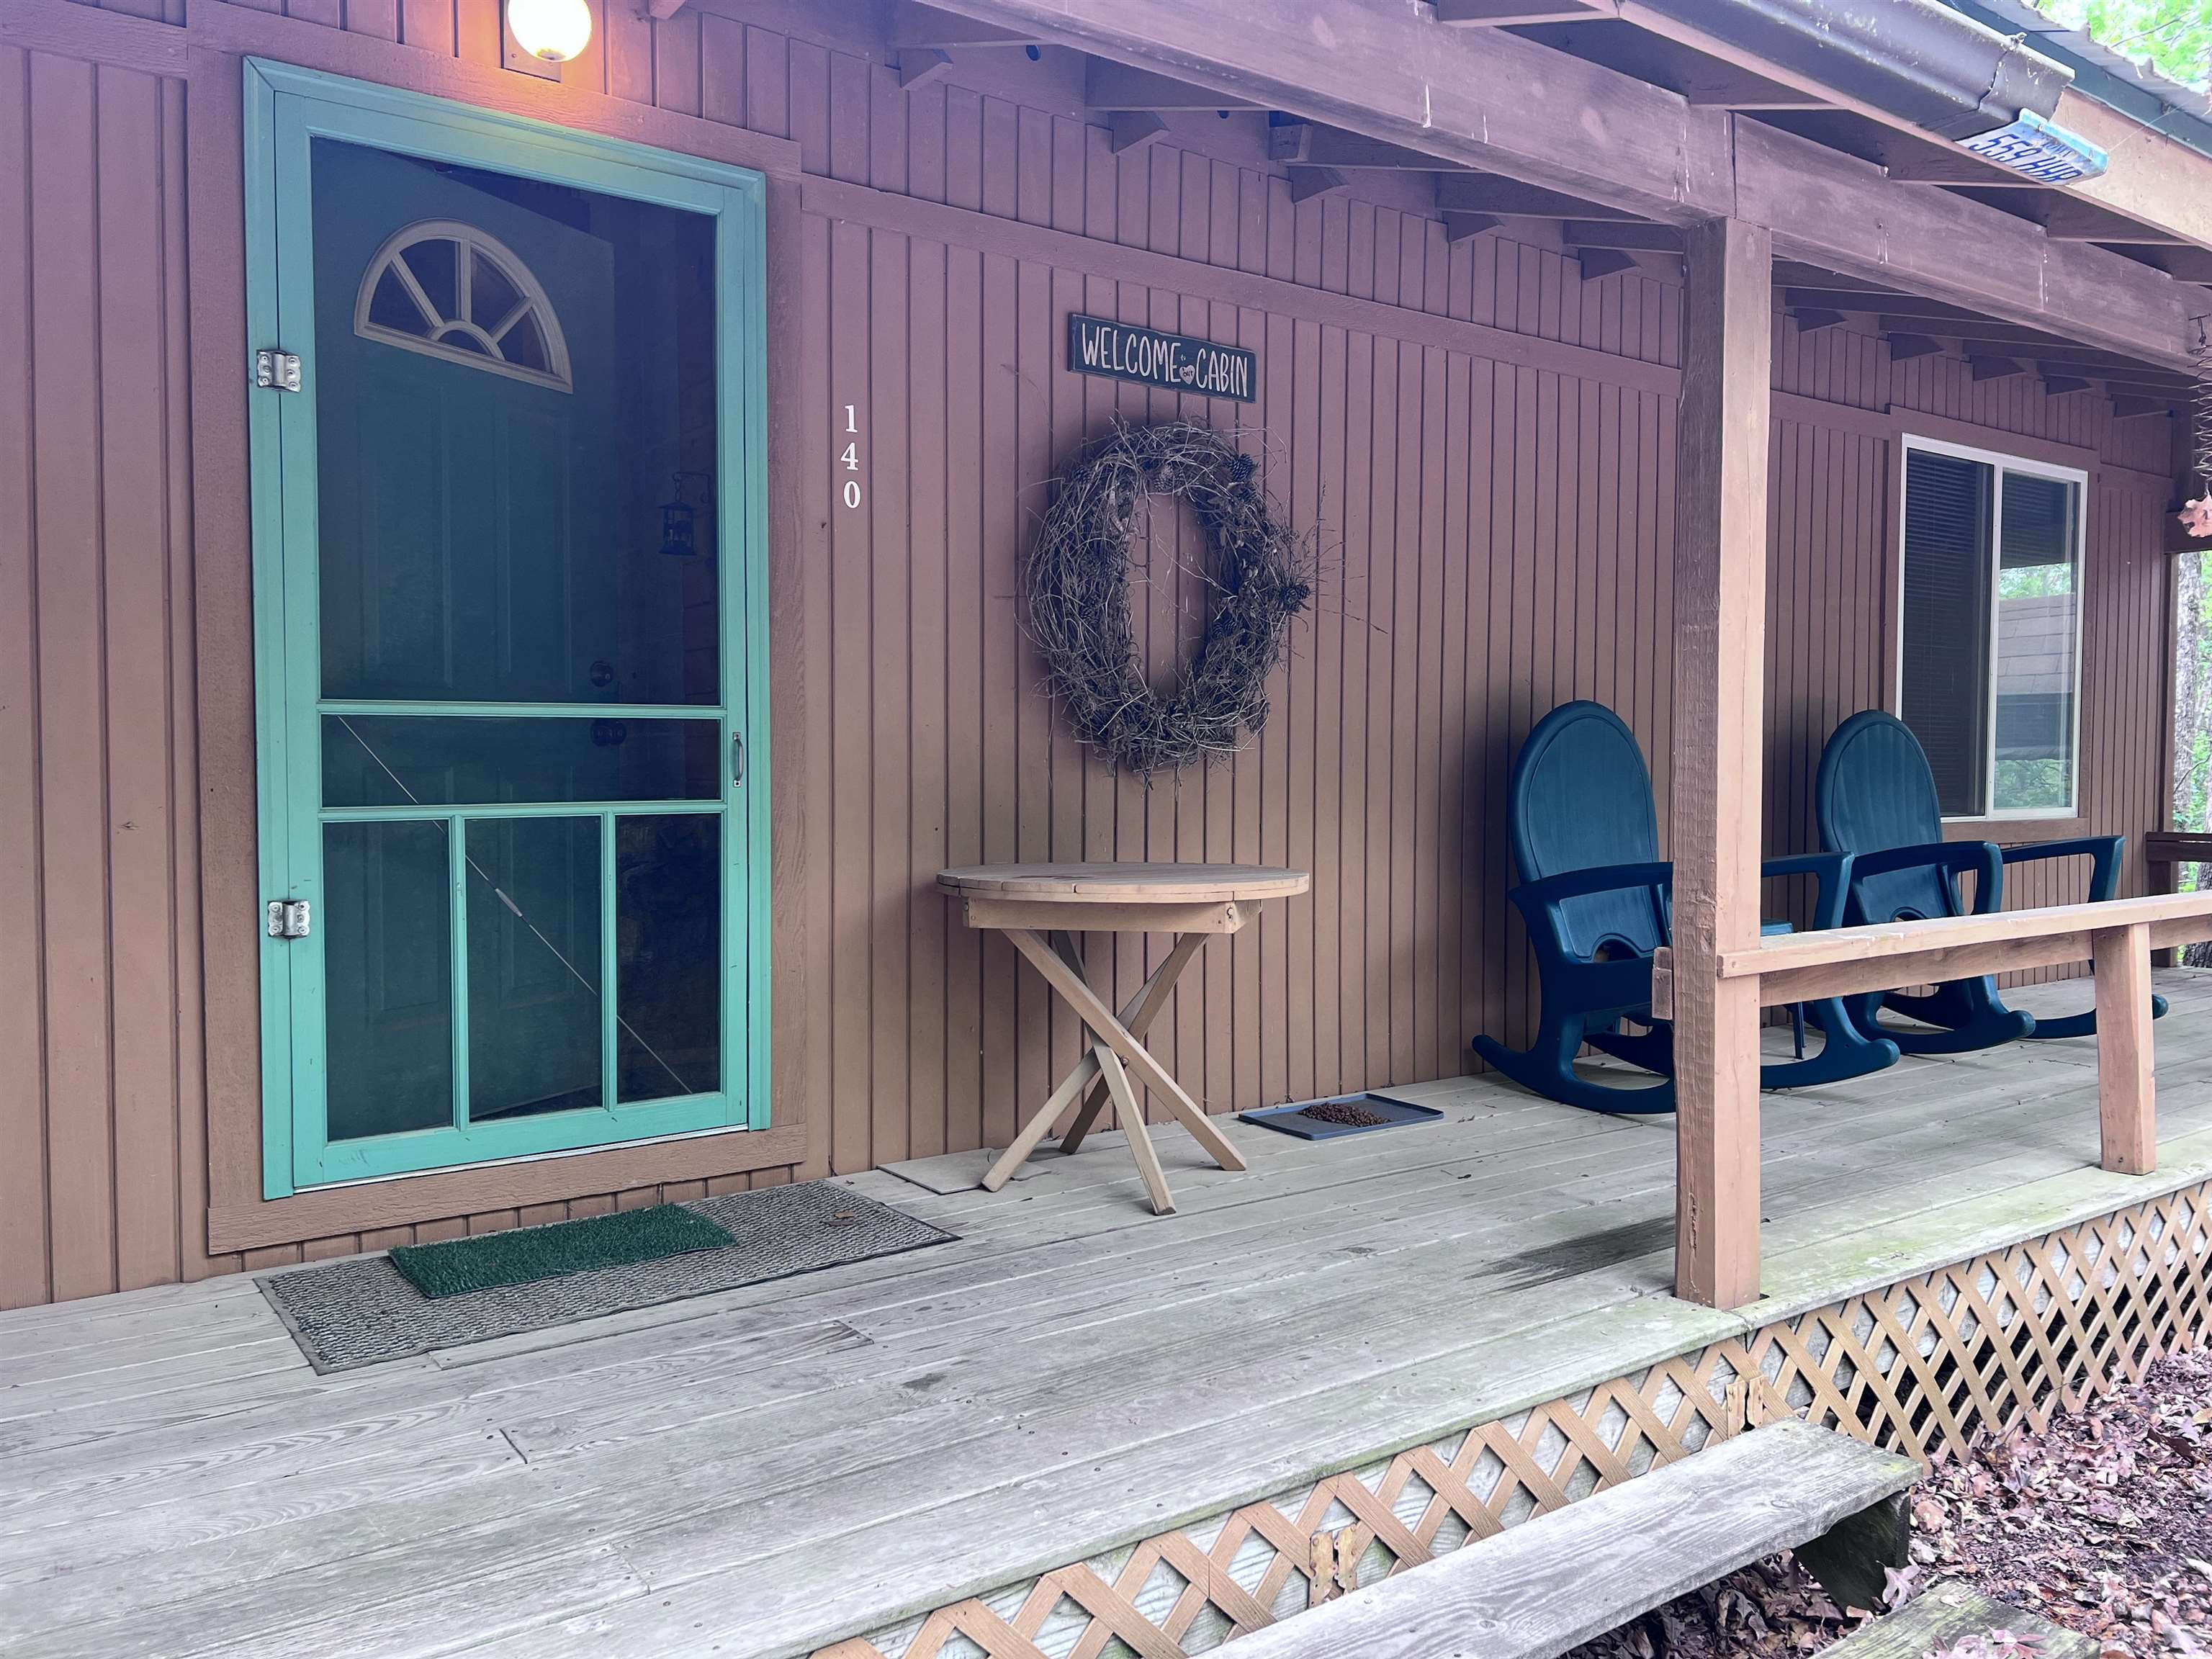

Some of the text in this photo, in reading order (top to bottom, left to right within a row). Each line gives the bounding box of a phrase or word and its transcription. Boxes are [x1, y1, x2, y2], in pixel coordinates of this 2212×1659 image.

[1968, 133, 2042, 163] 559
[1082, 323, 1182, 382] WELCOME
[1195, 348, 1248, 397] CABIN
[840, 405, 861, 509] 140
